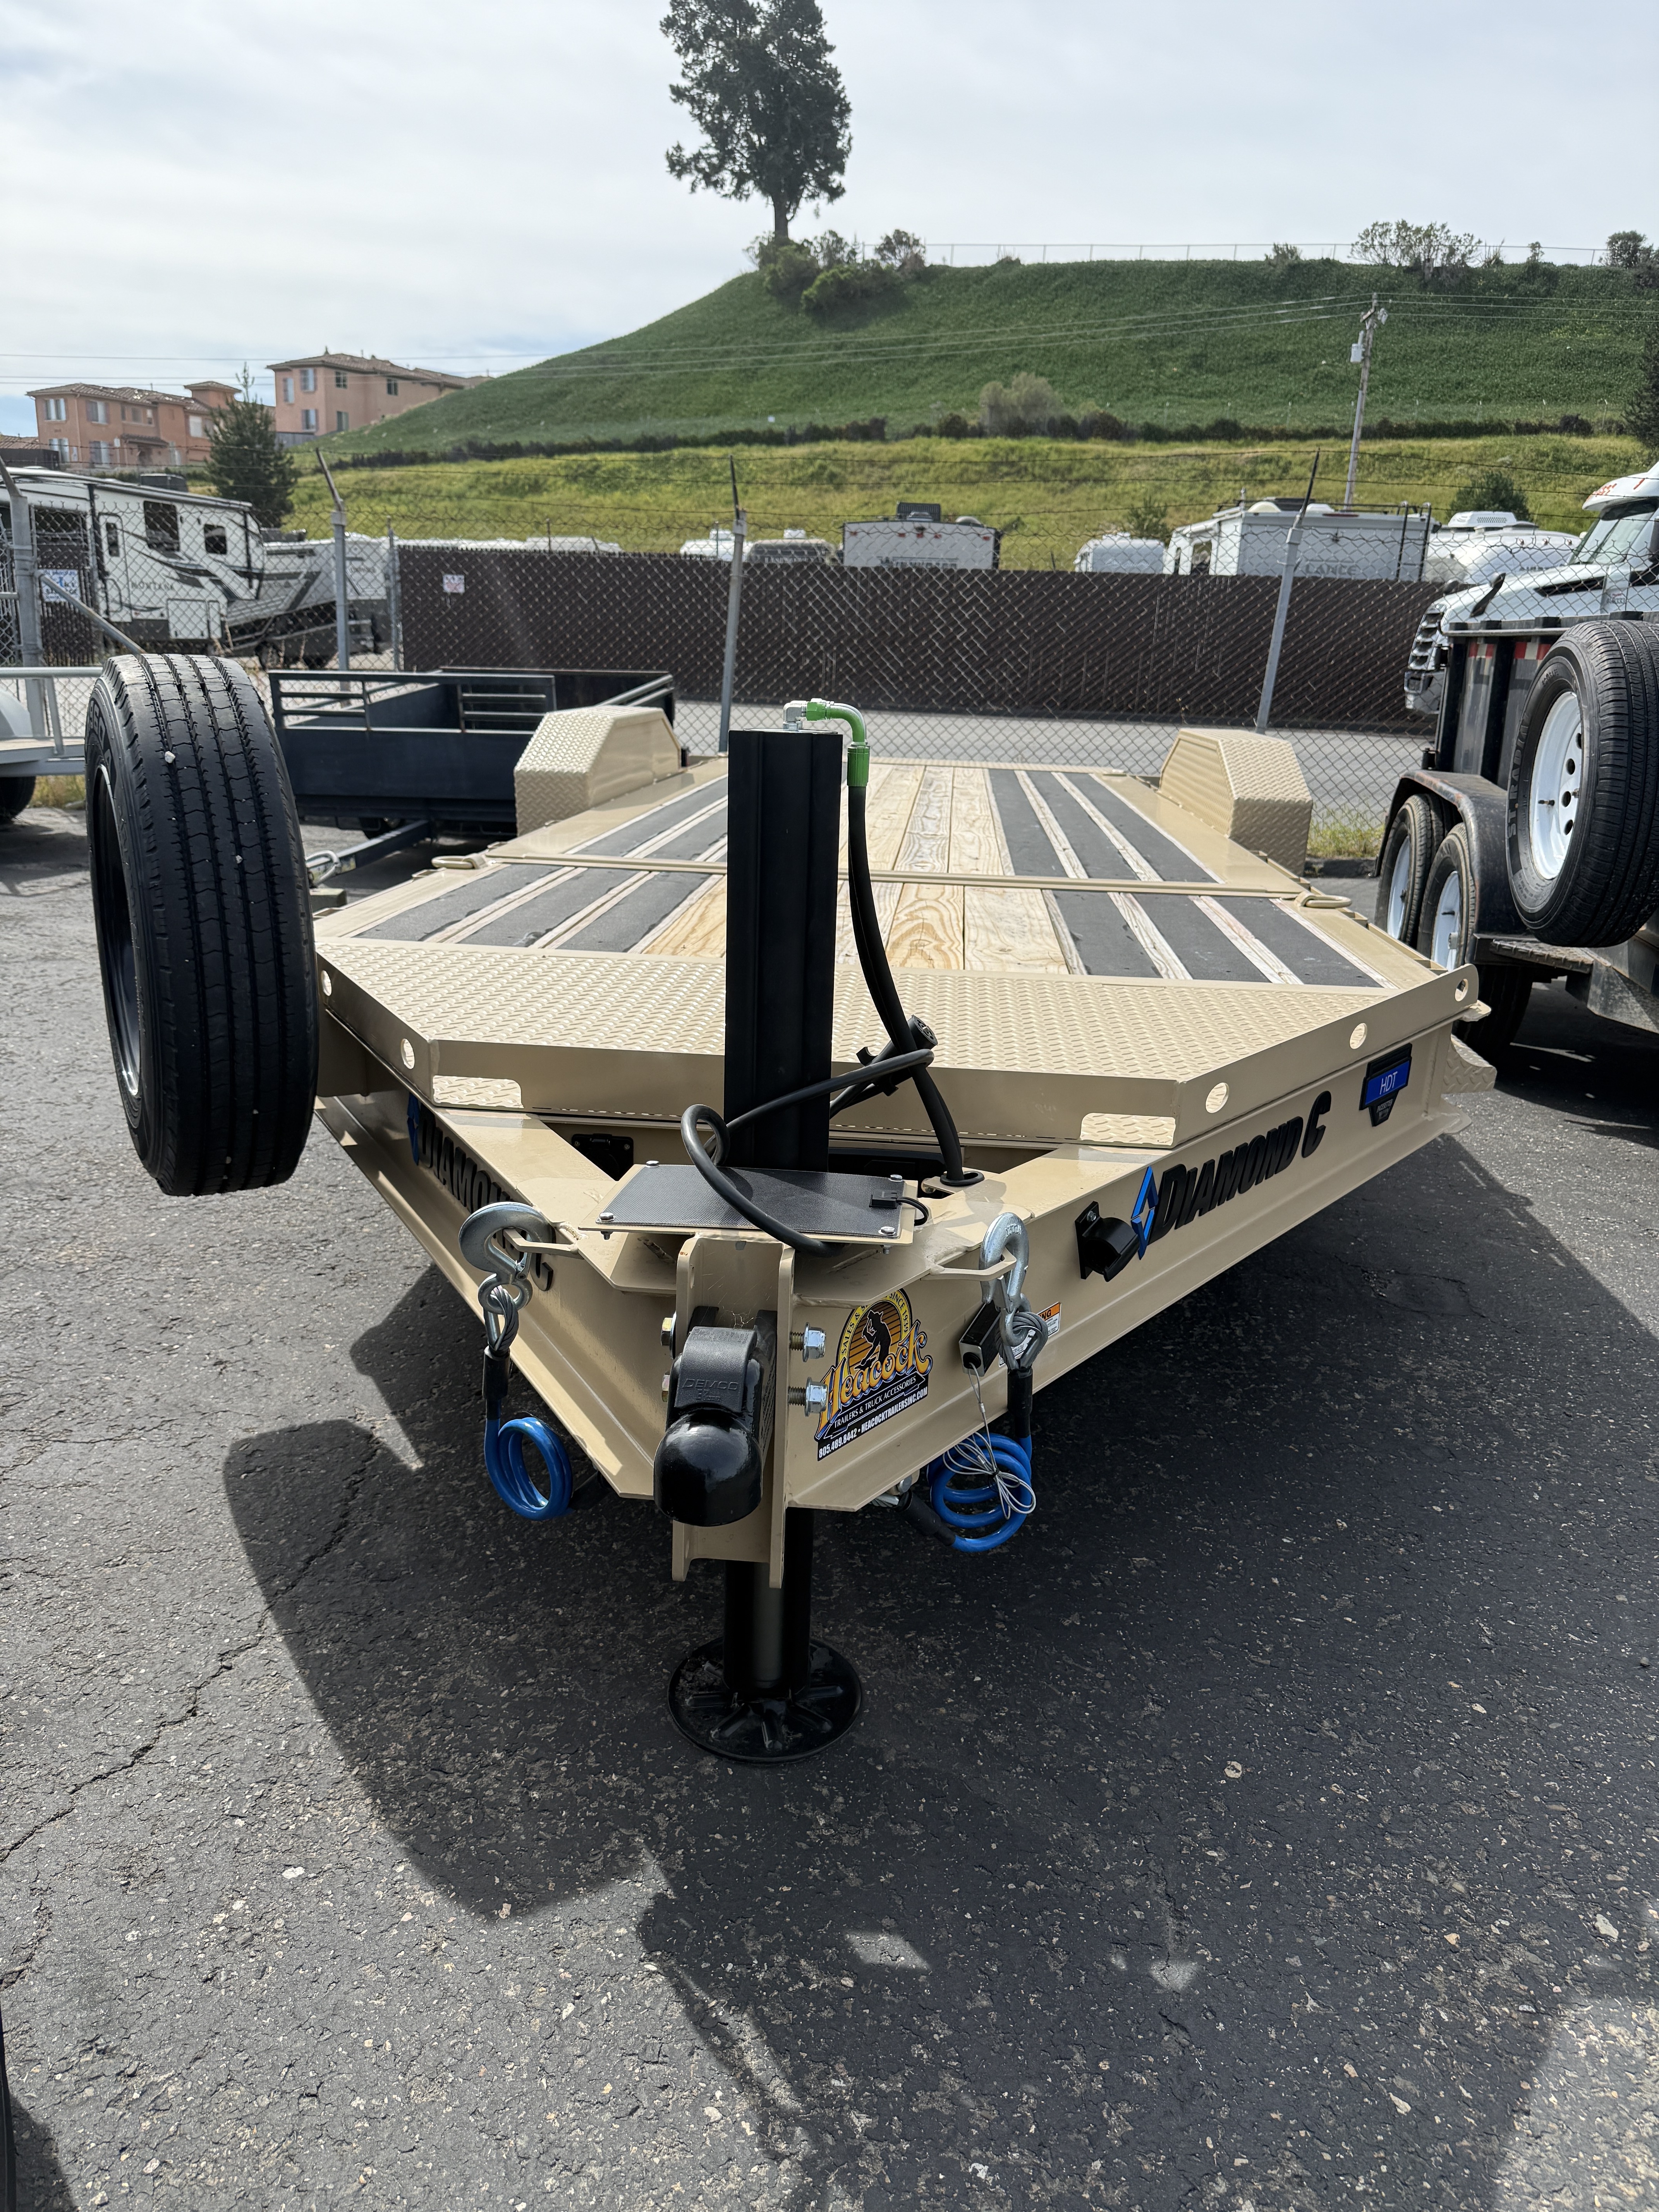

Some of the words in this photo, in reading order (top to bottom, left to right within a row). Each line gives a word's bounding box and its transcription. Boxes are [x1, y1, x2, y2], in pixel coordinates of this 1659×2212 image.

[1305, 563, 1356, 576] LANCE
[1379, 1071, 1398, 1095] HDT
[1147, 1116, 1304, 1246] DIAMOND
[1302, 1091, 1332, 1158] C
[841, 1322, 855, 1354] SALES
[855, 1312, 860, 1320] &
[682, 1378, 739, 1390] DEMCO
[816, 1321, 931, 1438] Heacock
[834, 1410, 859, 1428] TRAILERS
[864, 1397, 883, 1411] TRUCK
[883, 1376, 916, 1399] ACCESSORIES
[819, 1428, 857, 1458] 805.489.8442
[861, 1386, 928, 1433] HEACOCKTRAILERSINC.COM
